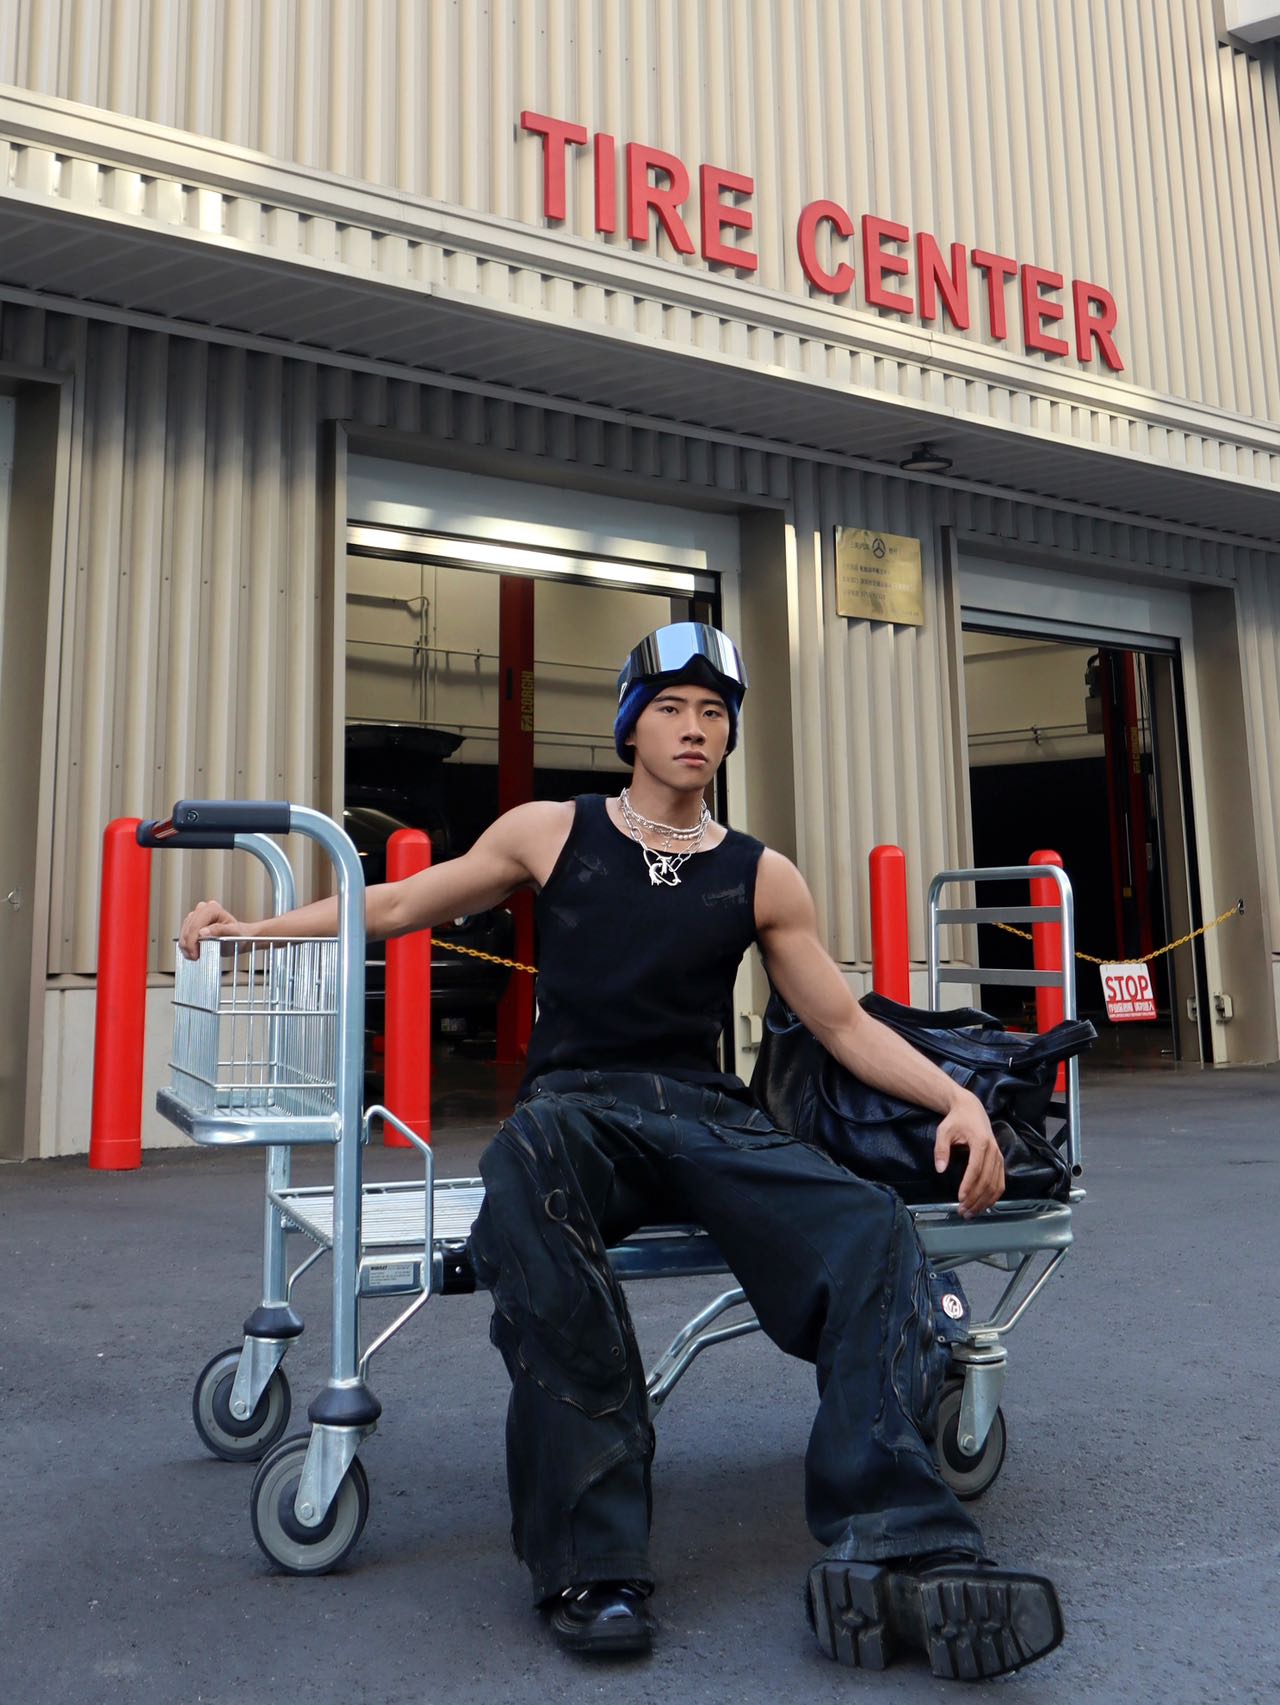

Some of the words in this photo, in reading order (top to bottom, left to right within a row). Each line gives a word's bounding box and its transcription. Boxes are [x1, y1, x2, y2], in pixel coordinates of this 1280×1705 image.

[520, 110, 758, 272] TIRE
[797, 199, 1124, 372] CENTER
[1106, 975, 1149, 1001] STOP
